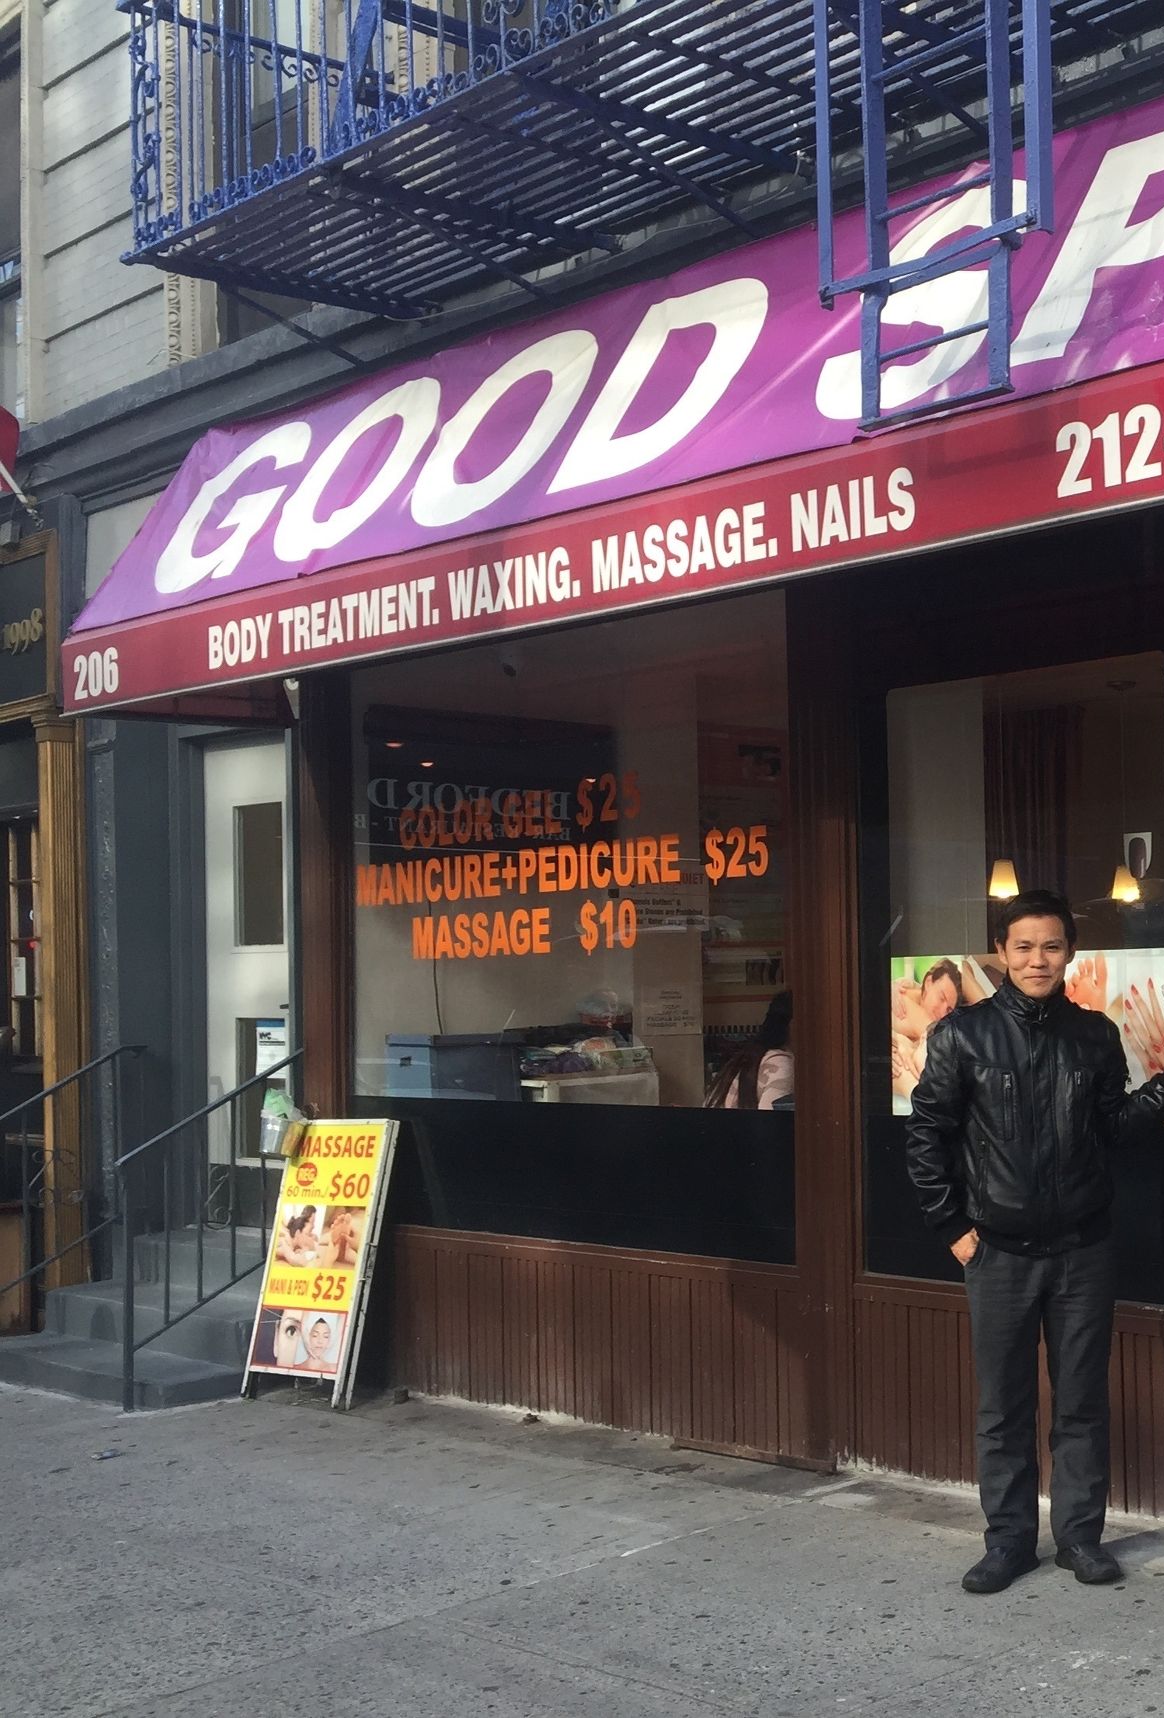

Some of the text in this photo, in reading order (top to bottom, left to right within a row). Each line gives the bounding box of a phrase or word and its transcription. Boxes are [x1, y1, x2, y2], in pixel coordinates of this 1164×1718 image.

[155, 277, 768, 594] GOOD
[73, 646, 119, 700] 206
[208, 612, 272, 670] BODY
[279, 577, 440, 655] TREATMENT.
[448, 547, 581, 622] WAXING.
[592, 506, 778, 592] MASSAGE.
[791, 467, 916, 552] NAILS
[400, 796, 494, 850] COLOR
[576, 770, 641, 833] $25
[356, 824, 768, 906] MANICURE+PEDICURE $25
[412, 900, 637, 960] MASSAGE $10
[299, 1135, 377, 1158] MASSAGE
[286, 1185, 300, 1197] 60
[329, 1170, 371, 1202] $60
[311, 1272, 347, 1302] $25
